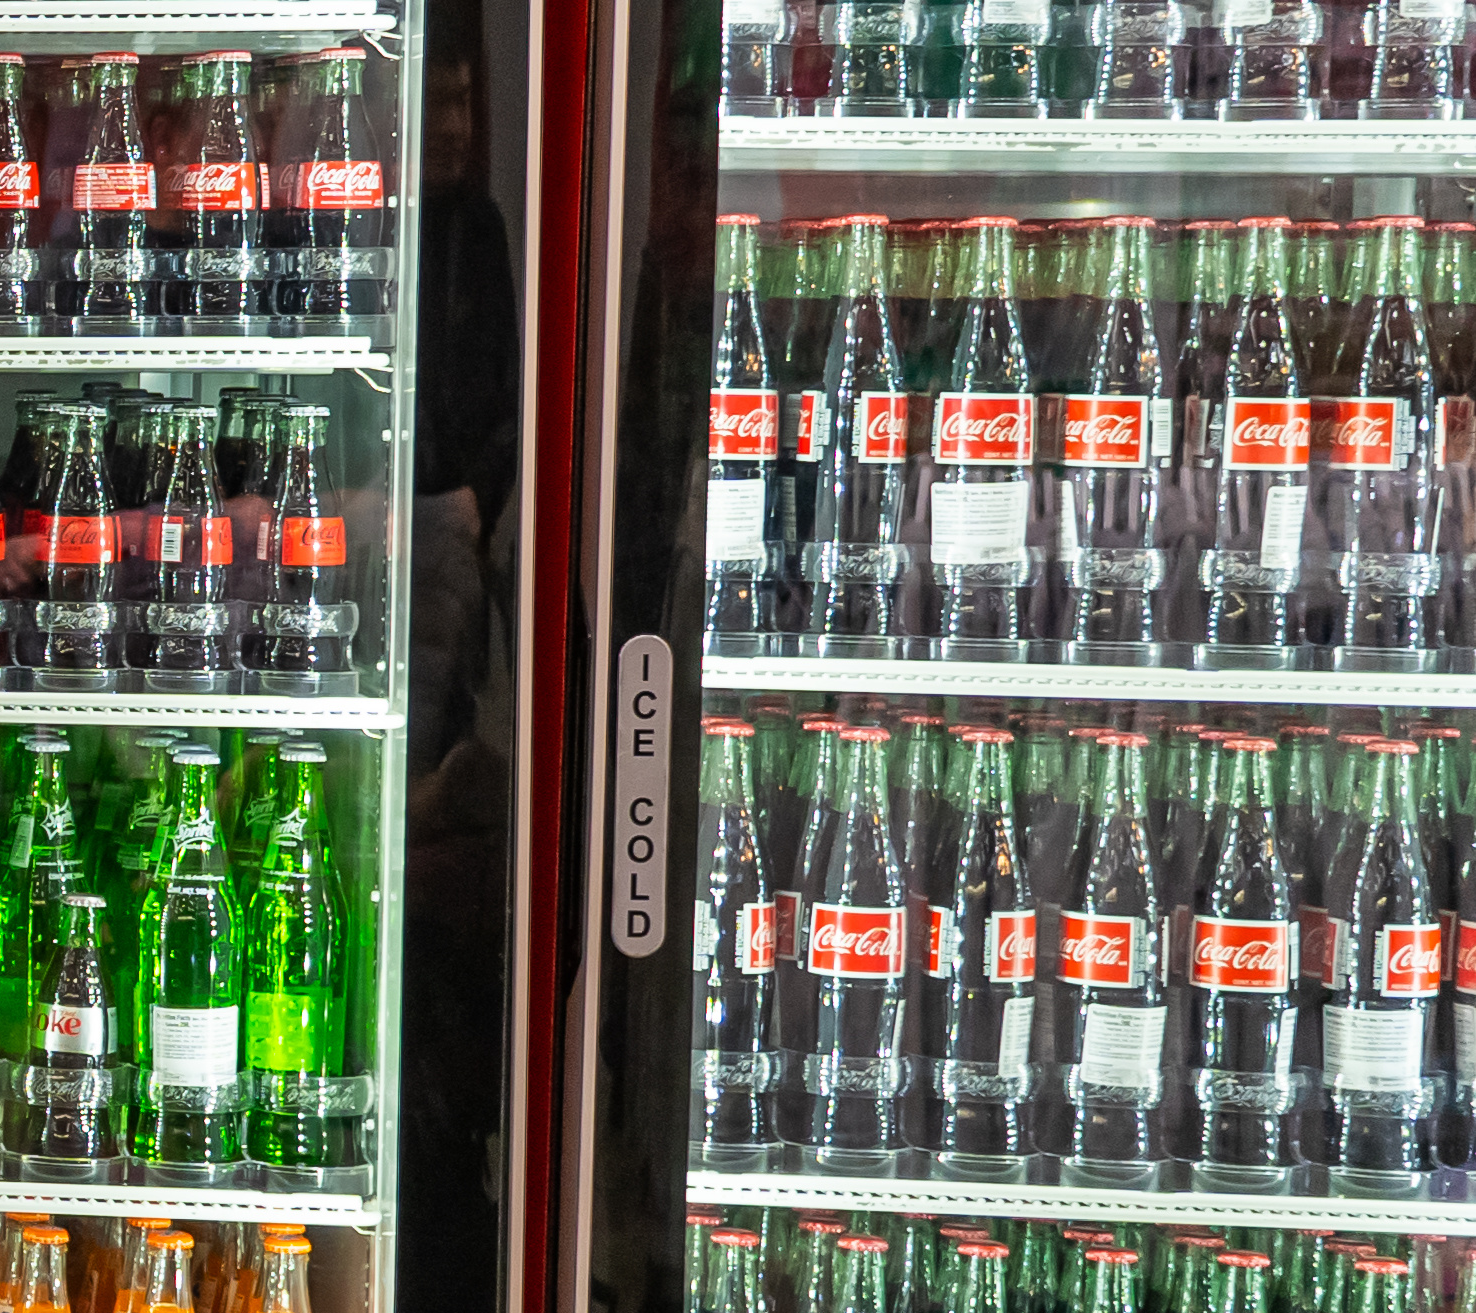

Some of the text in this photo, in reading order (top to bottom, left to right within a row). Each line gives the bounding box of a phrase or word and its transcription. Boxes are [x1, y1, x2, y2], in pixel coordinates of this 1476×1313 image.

[941, 410, 1031, 443] Coca-Cola
[626, 653, 657, 939] ICE COLD
[812, 923, 902, 958] Coca-Cola
[1194, 936, 1285, 972] Coca-Cola
